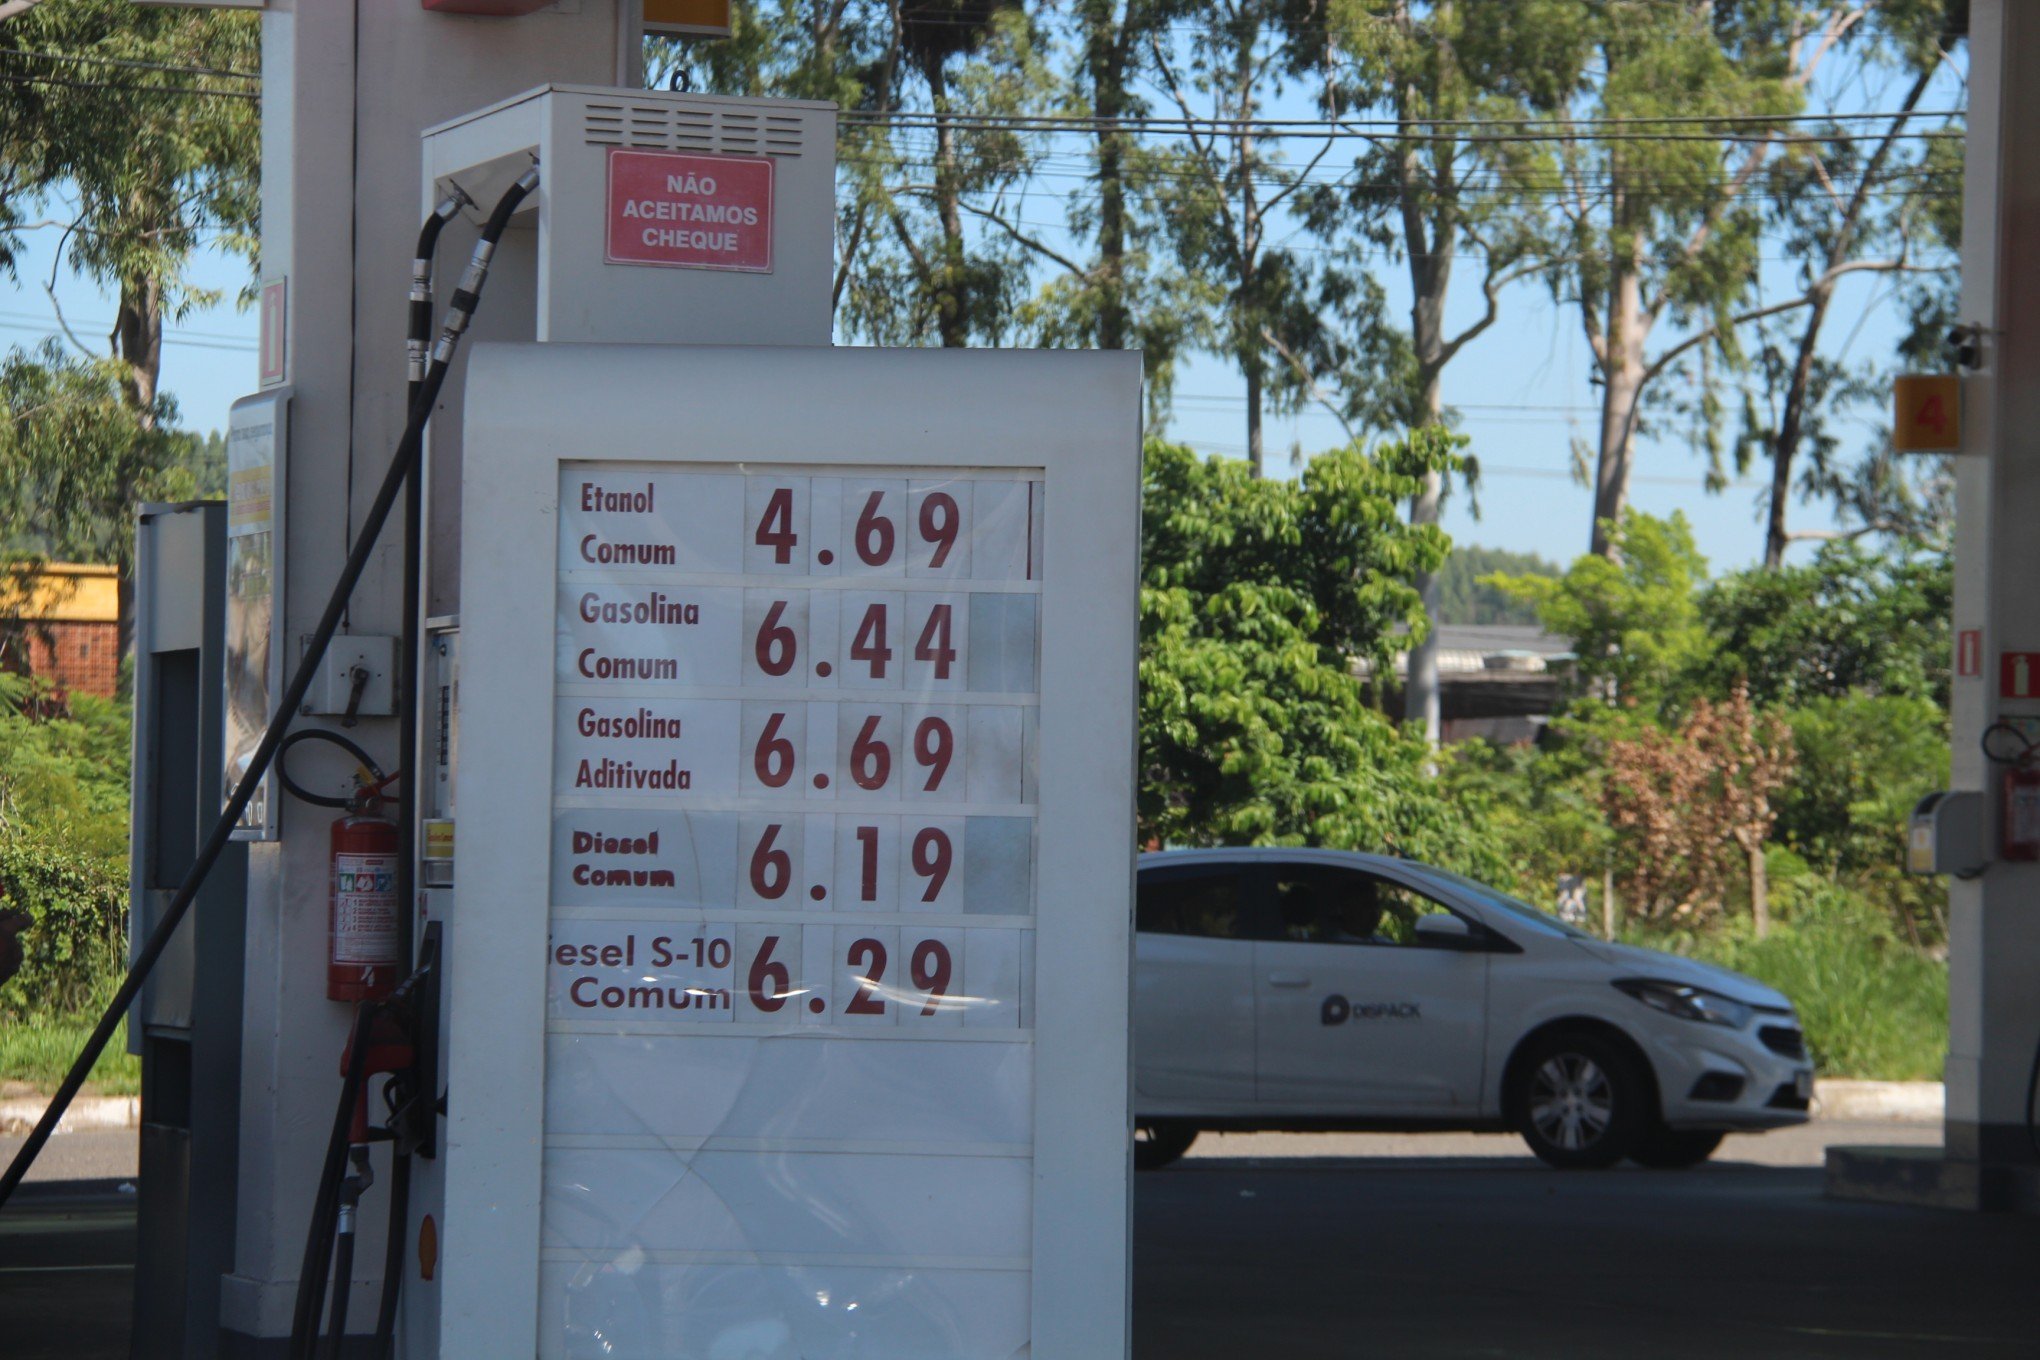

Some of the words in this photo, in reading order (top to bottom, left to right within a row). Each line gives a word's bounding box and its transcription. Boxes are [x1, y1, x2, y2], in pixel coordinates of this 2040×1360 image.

[667, 172, 717, 196] NÃO
[622, 199, 758, 226] ACEITAMOS
[642, 228, 739, 251] CHEQUE
[1915, 394, 1948, 436] 4
[581, 482, 654, 513] Etanol
[580, 534, 675, 565] Comum
[579, 592, 699, 626] Gasolina
[577, 647, 678, 680] Comum
[577, 707, 681, 739] Gasolina
[575, 759, 691, 790] Aditivada
[572, 829, 659, 855] Diesel
[572, 864, 675, 888] Comum
[651, 937, 732, 969] S-10
[570, 976, 731, 1010] Comum
